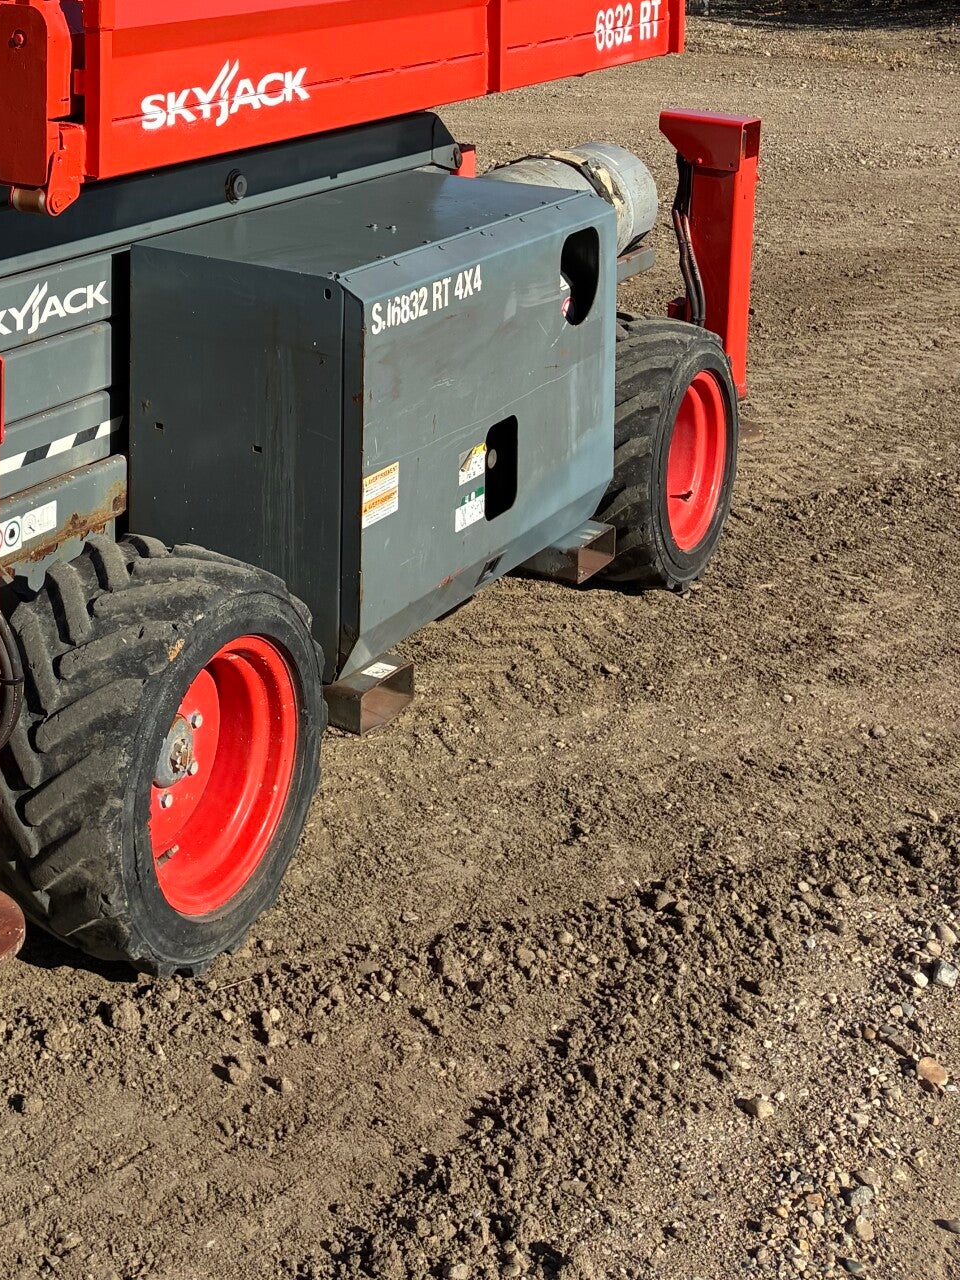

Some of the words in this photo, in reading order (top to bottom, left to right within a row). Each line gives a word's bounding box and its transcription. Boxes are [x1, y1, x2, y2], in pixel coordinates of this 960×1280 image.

[595, 2, 633, 51] 6832
[141, 59, 310, 130] SKYJACK
[432, 277, 451, 311] RT
